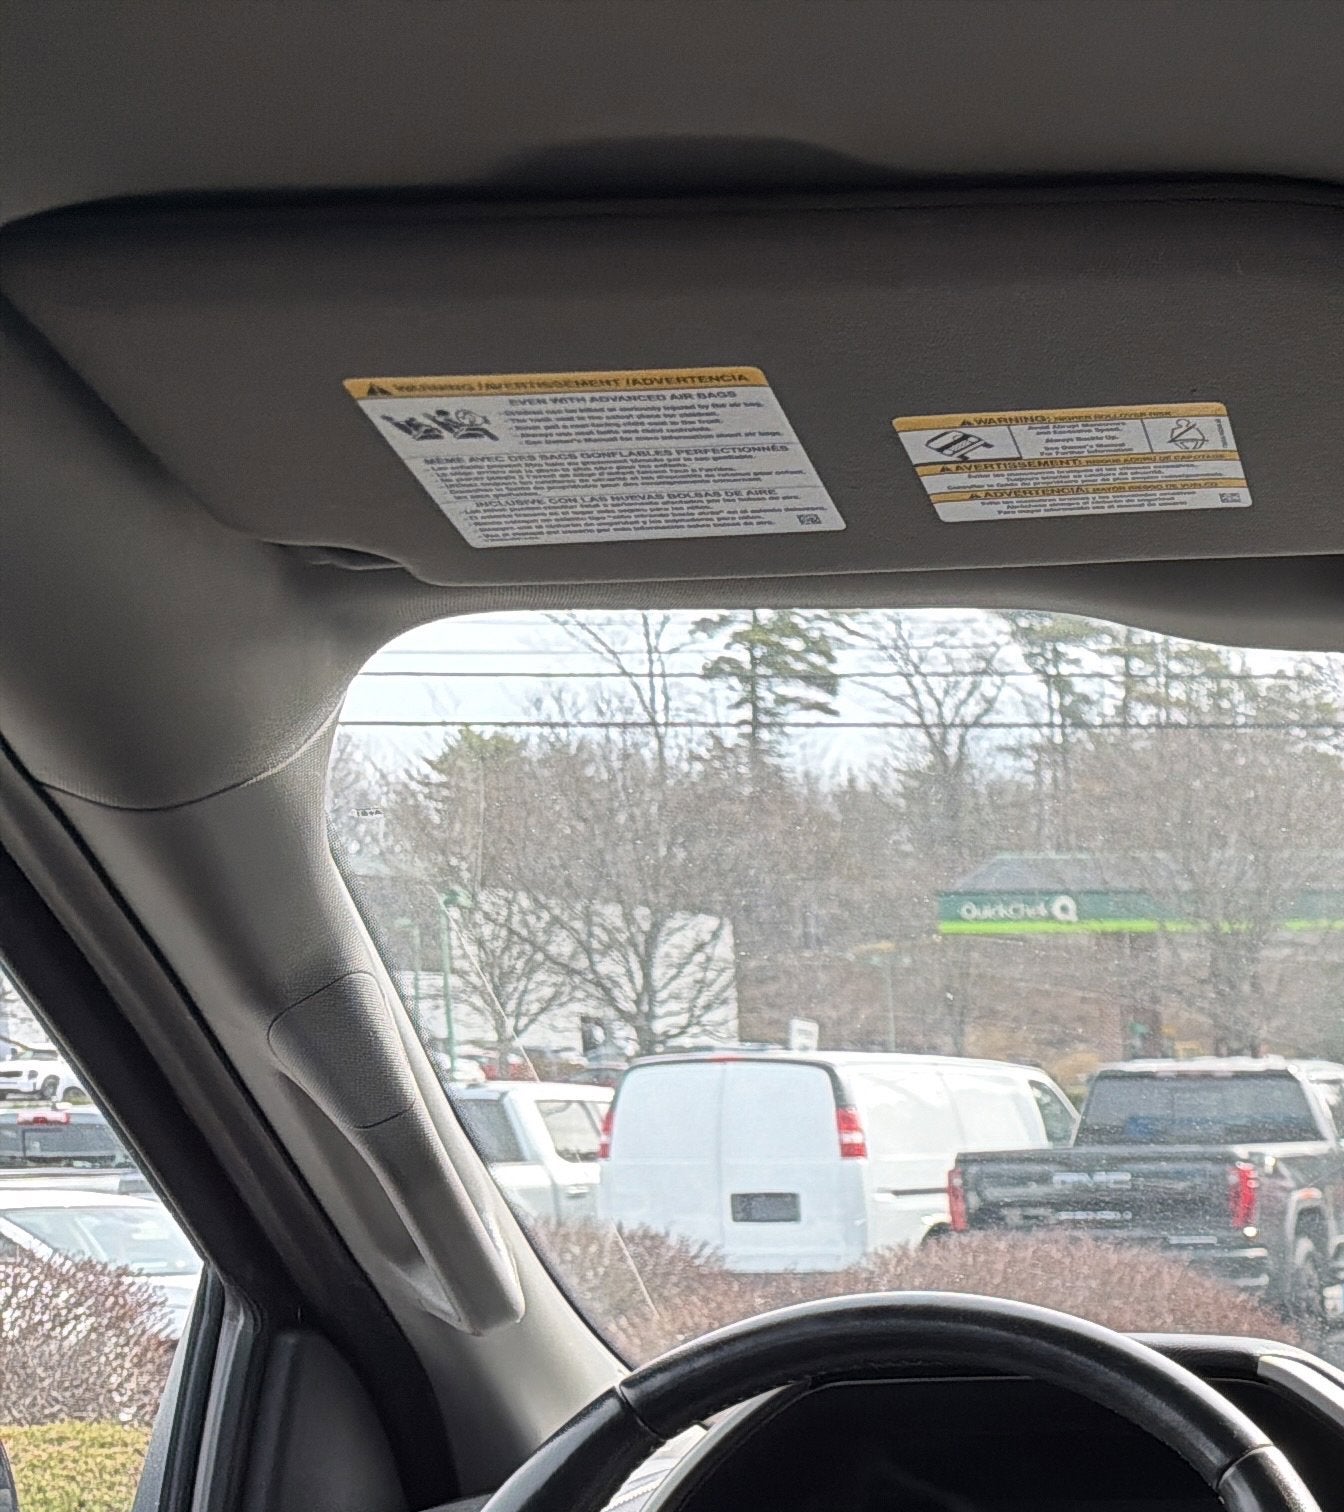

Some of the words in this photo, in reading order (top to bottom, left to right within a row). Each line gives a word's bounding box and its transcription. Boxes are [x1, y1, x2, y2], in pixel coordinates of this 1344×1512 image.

[587, 393, 667, 403] ADVANCED
[667, 391, 695, 400] AIR
[695, 390, 738, 398] BAGS
